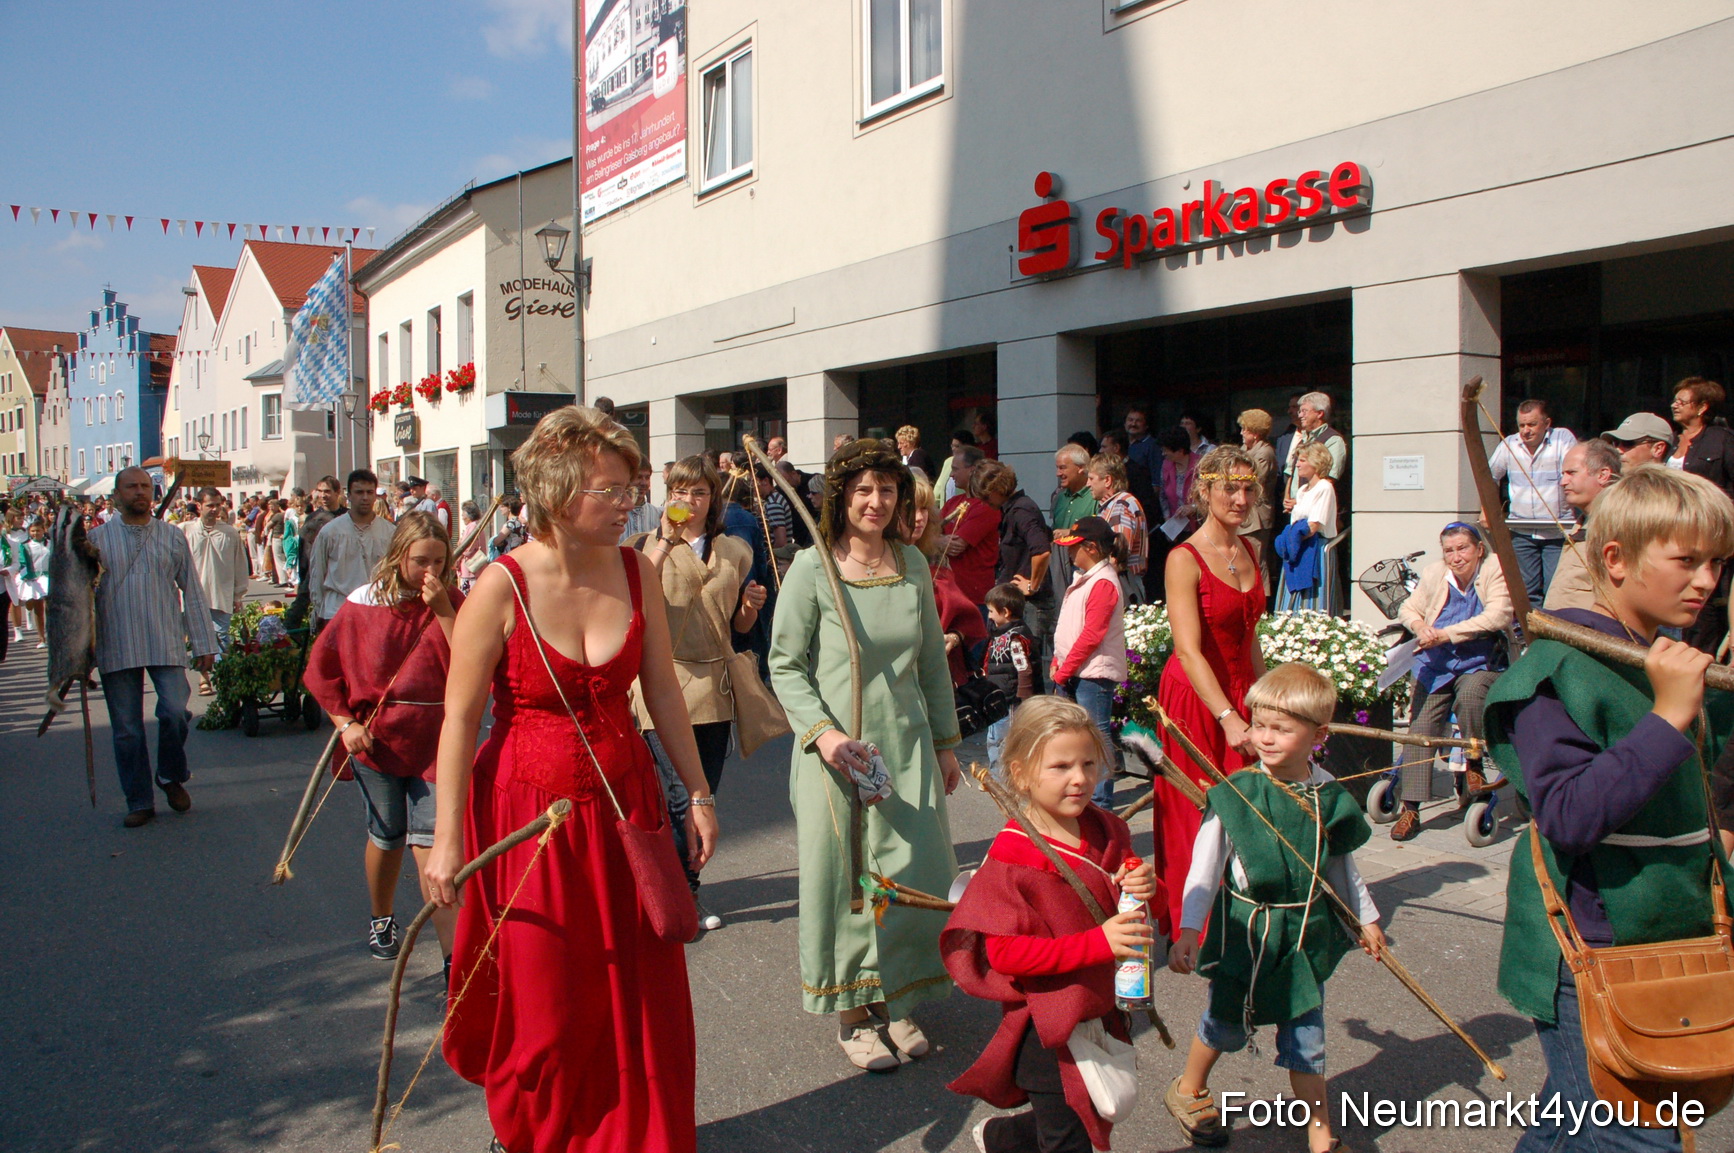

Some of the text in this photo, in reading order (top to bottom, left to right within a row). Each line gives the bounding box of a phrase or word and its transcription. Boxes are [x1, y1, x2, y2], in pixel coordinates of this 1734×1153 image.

[656, 50, 667, 79] B
[586, 159, 596, 170] Was
[597, 148, 613, 165] wurde
[614, 143, 622, 155] bis
[640, 111, 675, 139] Jahrhundert
[586, 175, 594, 185] am
[648, 124, 680, 151] angebaut?
[1095, 161, 1367, 269] Sparkasse
[500, 278, 575, 298] MODEHAUS
